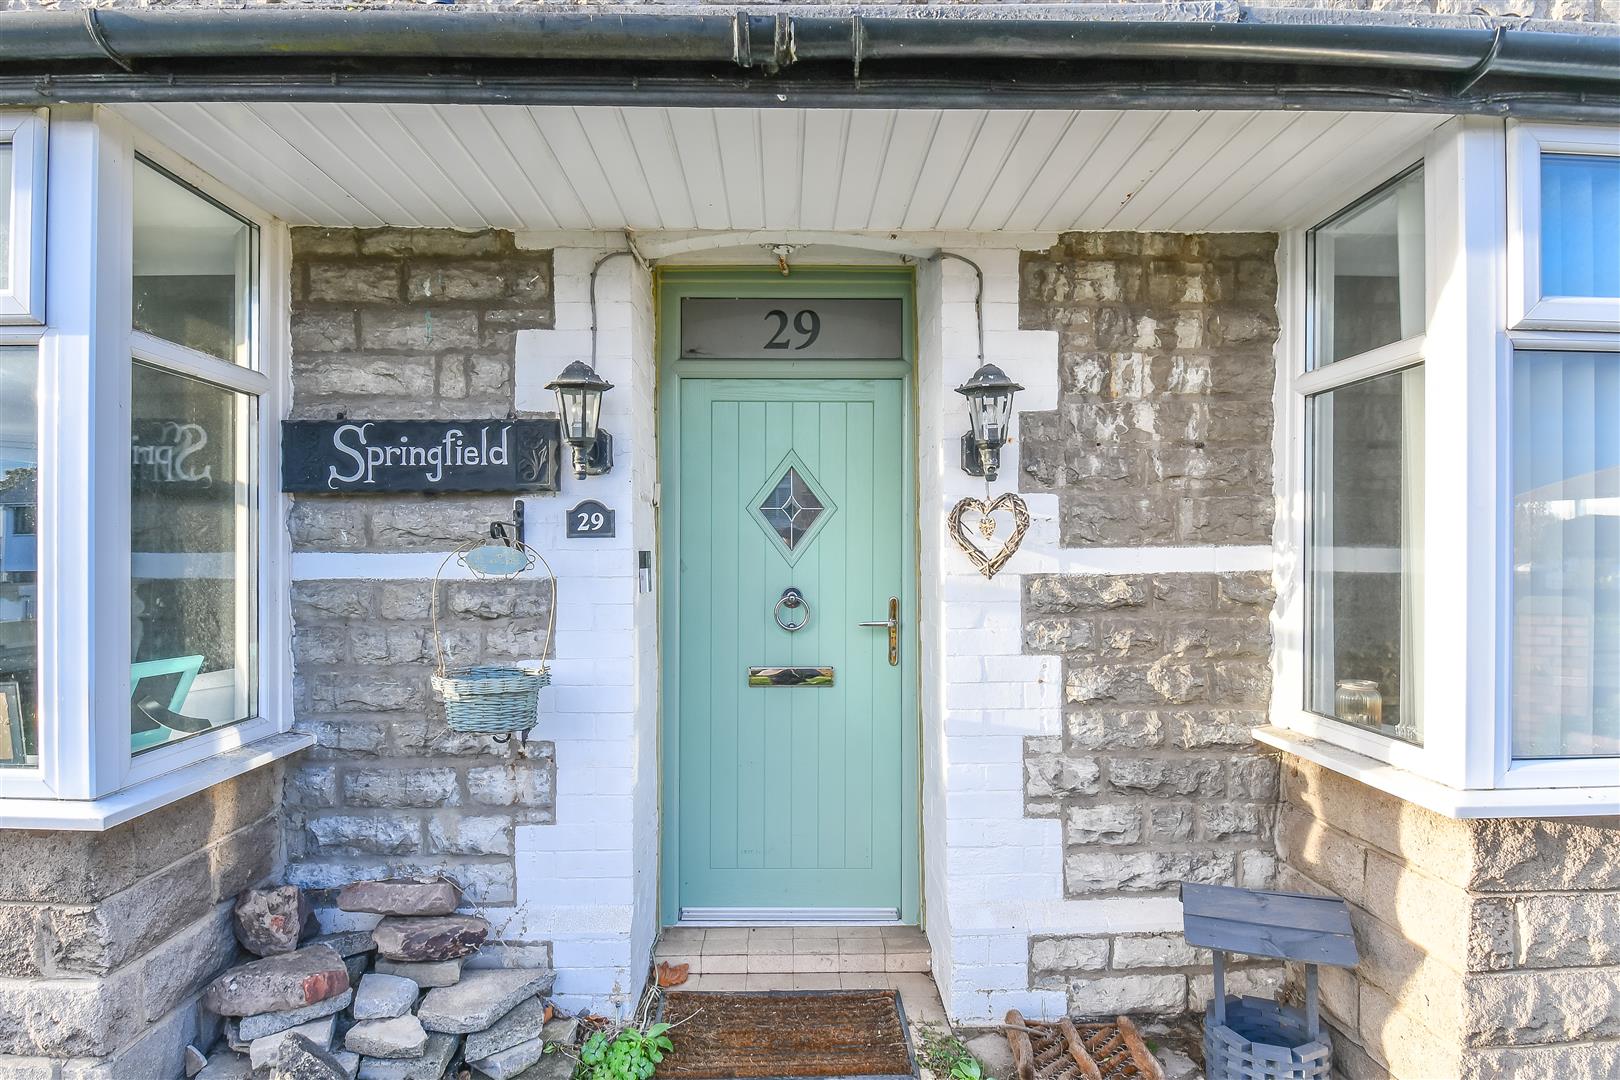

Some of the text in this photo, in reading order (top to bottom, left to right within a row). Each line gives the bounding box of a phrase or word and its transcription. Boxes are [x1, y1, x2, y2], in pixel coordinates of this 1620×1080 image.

[763, 309, 821, 350] 29
[327, 422, 512, 490] Springfield
[577, 512, 604, 531] 29
